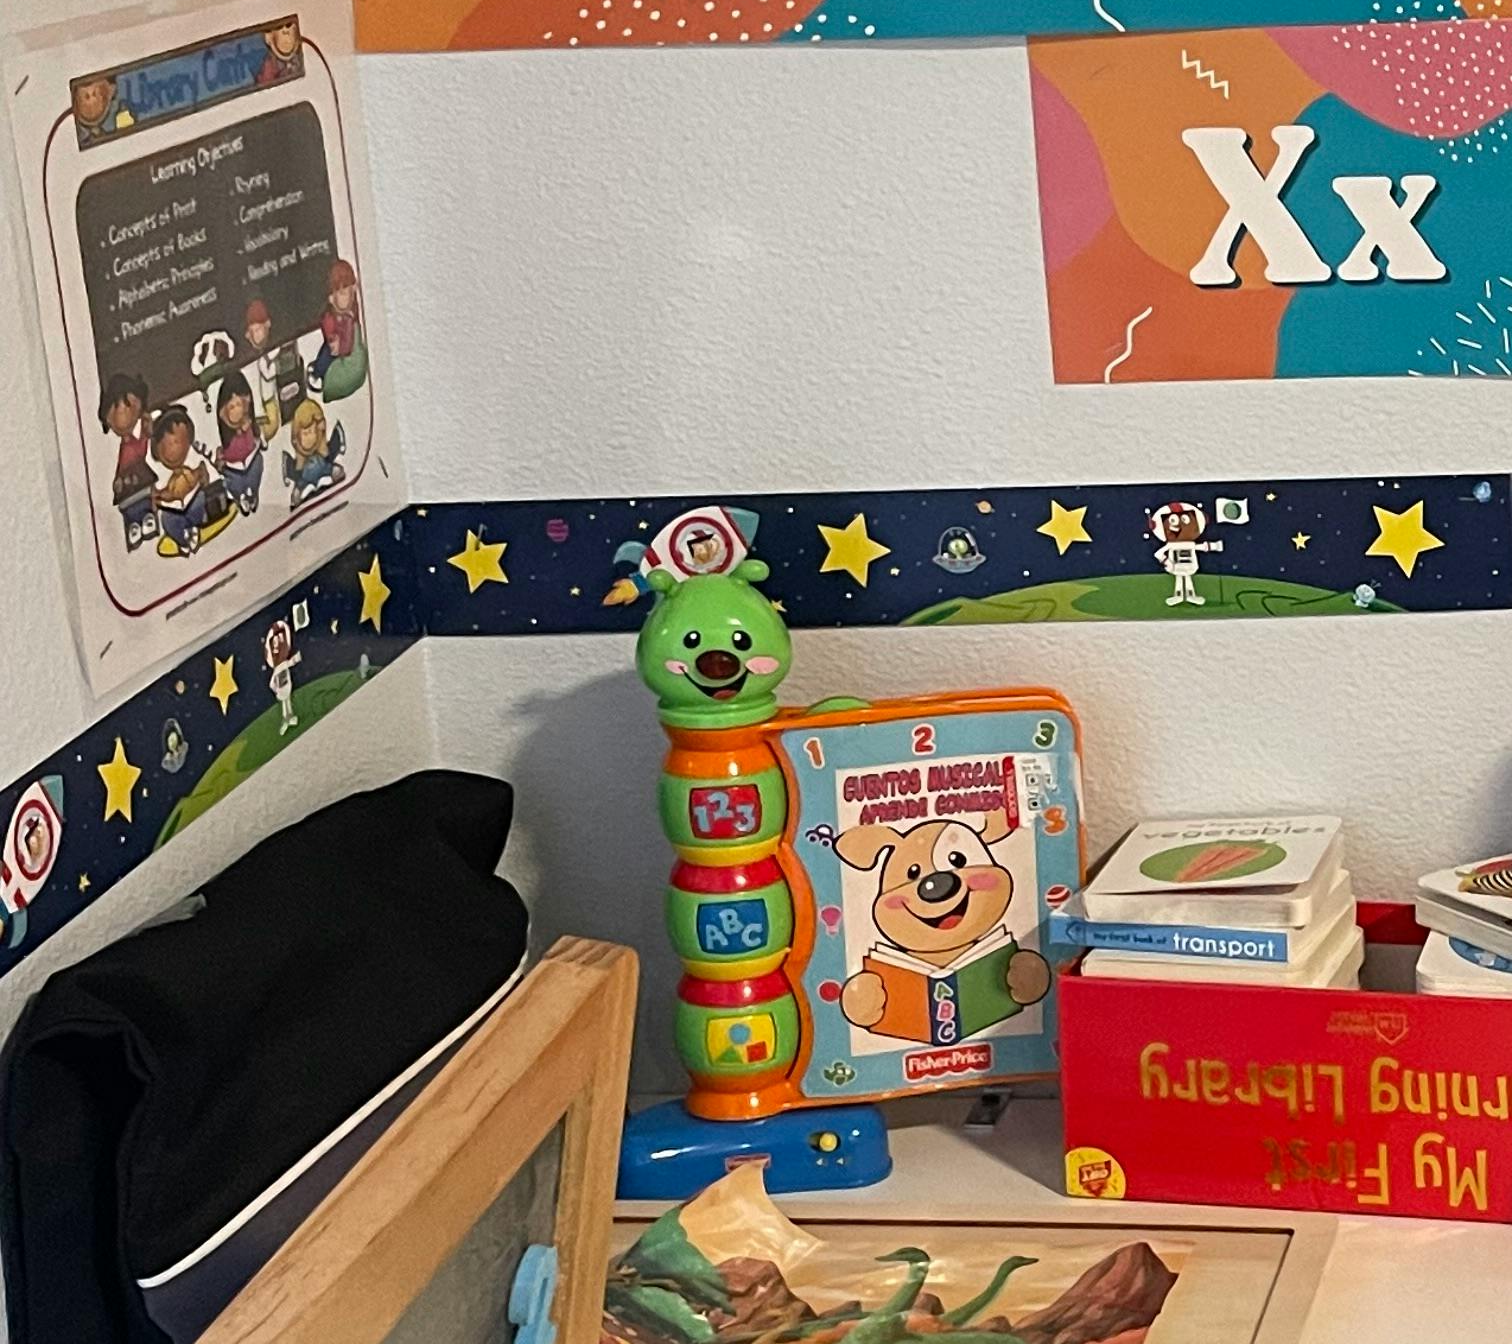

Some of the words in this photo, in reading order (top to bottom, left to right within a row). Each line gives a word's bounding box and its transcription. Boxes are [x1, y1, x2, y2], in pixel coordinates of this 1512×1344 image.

[1182, 125, 1451, 285] Xx
[913, 724, 936, 754] 2
[1033, 720, 1056, 748] 3
[1143, 824, 1325, 840] vegetables
[1173, 932, 1276, 957] transport
[1140, 1043, 1344, 1125] Library
[1262, 1136, 1390, 1206] First
[1413, 1132, 1489, 1212] My
